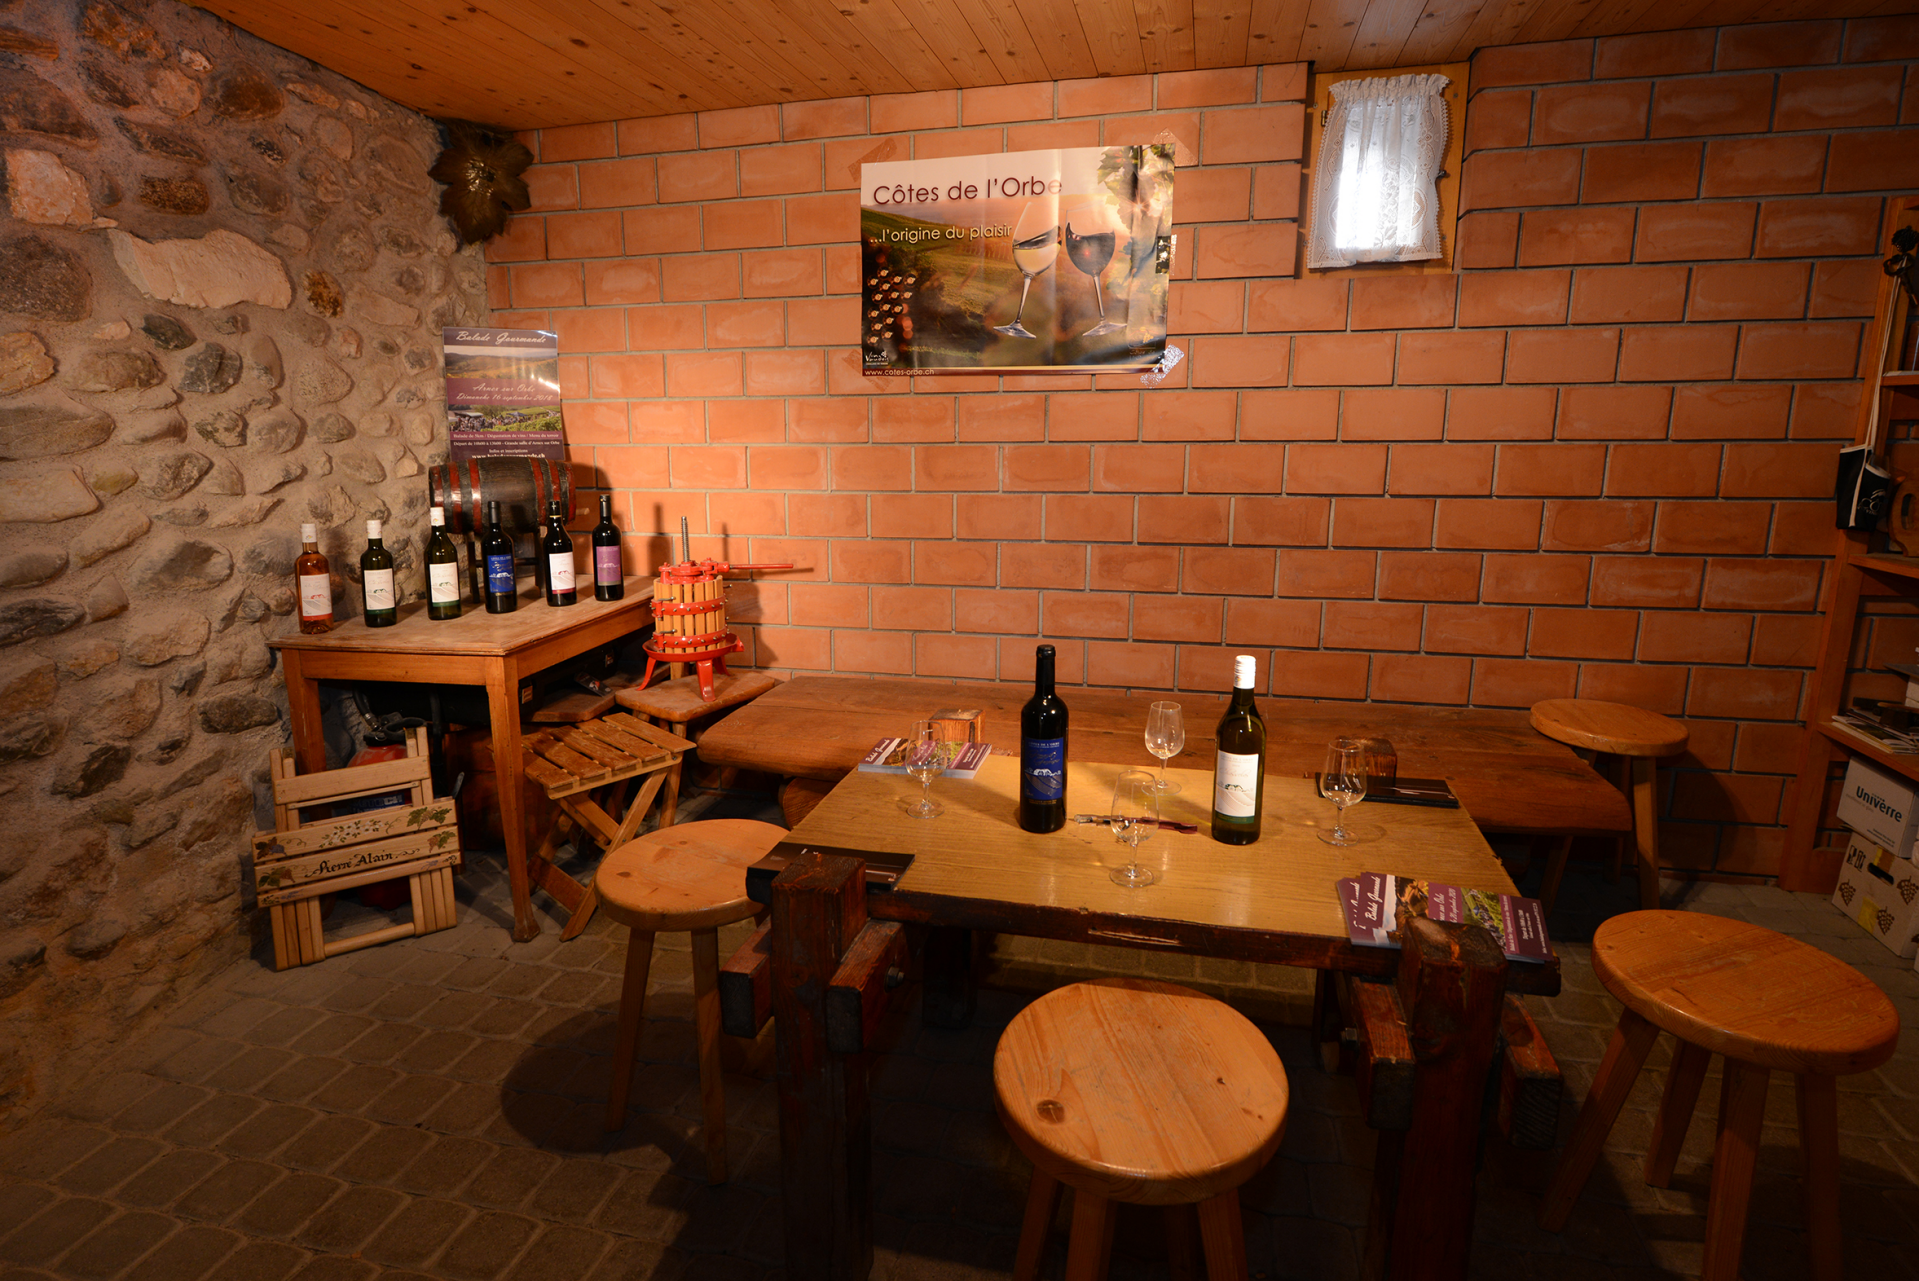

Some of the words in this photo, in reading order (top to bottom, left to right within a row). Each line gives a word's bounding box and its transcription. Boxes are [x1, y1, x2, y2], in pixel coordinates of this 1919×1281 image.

[873, 184, 940, 205] Côtes
[947, 180, 979, 201] de
[987, 175, 1063, 199] l'Orbe
[869, 226, 941, 244] ...l'origine
[945, 225, 965, 241] du
[969, 223, 1013, 241] plaisir
[455, 331, 491, 342] Balade
[495, 332, 547, 345] Gourmande
[864, 368, 935, 376] www.cotes-orbe.ch
[472, 382, 499, 392] Arnex
[516, 383, 536, 393] Orbe
[456, 393, 490, 401] Dimanche
[492, 393, 502, 401] 16
[502, 393, 533, 403] septembre
[1856, 785, 1903, 822] Univerre
[316, 860, 352, 875] Pierre
[353, 850, 393, 867] Alain
[1367, 876, 1383, 904] Gourmande
[1365, 905, 1378, 922] Balade
